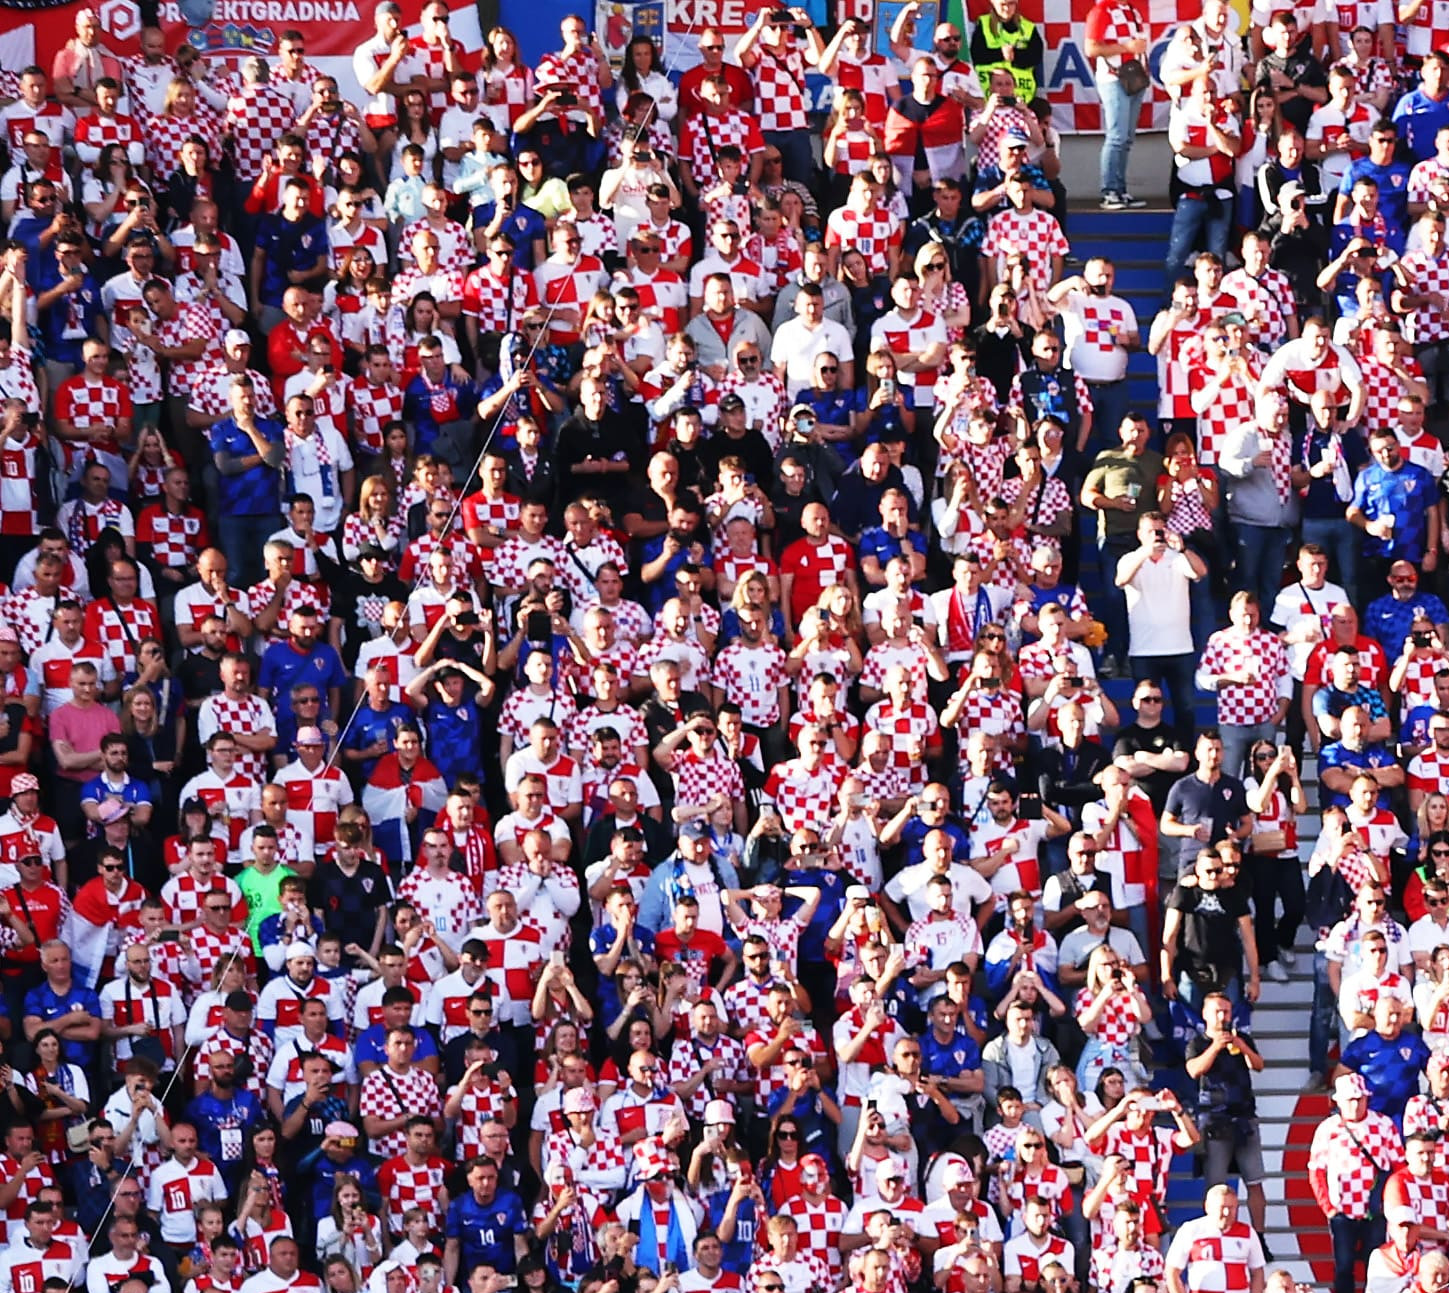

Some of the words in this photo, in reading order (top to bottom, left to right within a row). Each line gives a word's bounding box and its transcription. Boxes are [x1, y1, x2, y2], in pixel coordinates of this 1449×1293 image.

[158, 0, 361, 22] PREKTGRADNJA
[172, 1192, 185, 1209] 10
[737, 1221, 751, 1242] 10
[22, 1276, 36, 1291] 10
